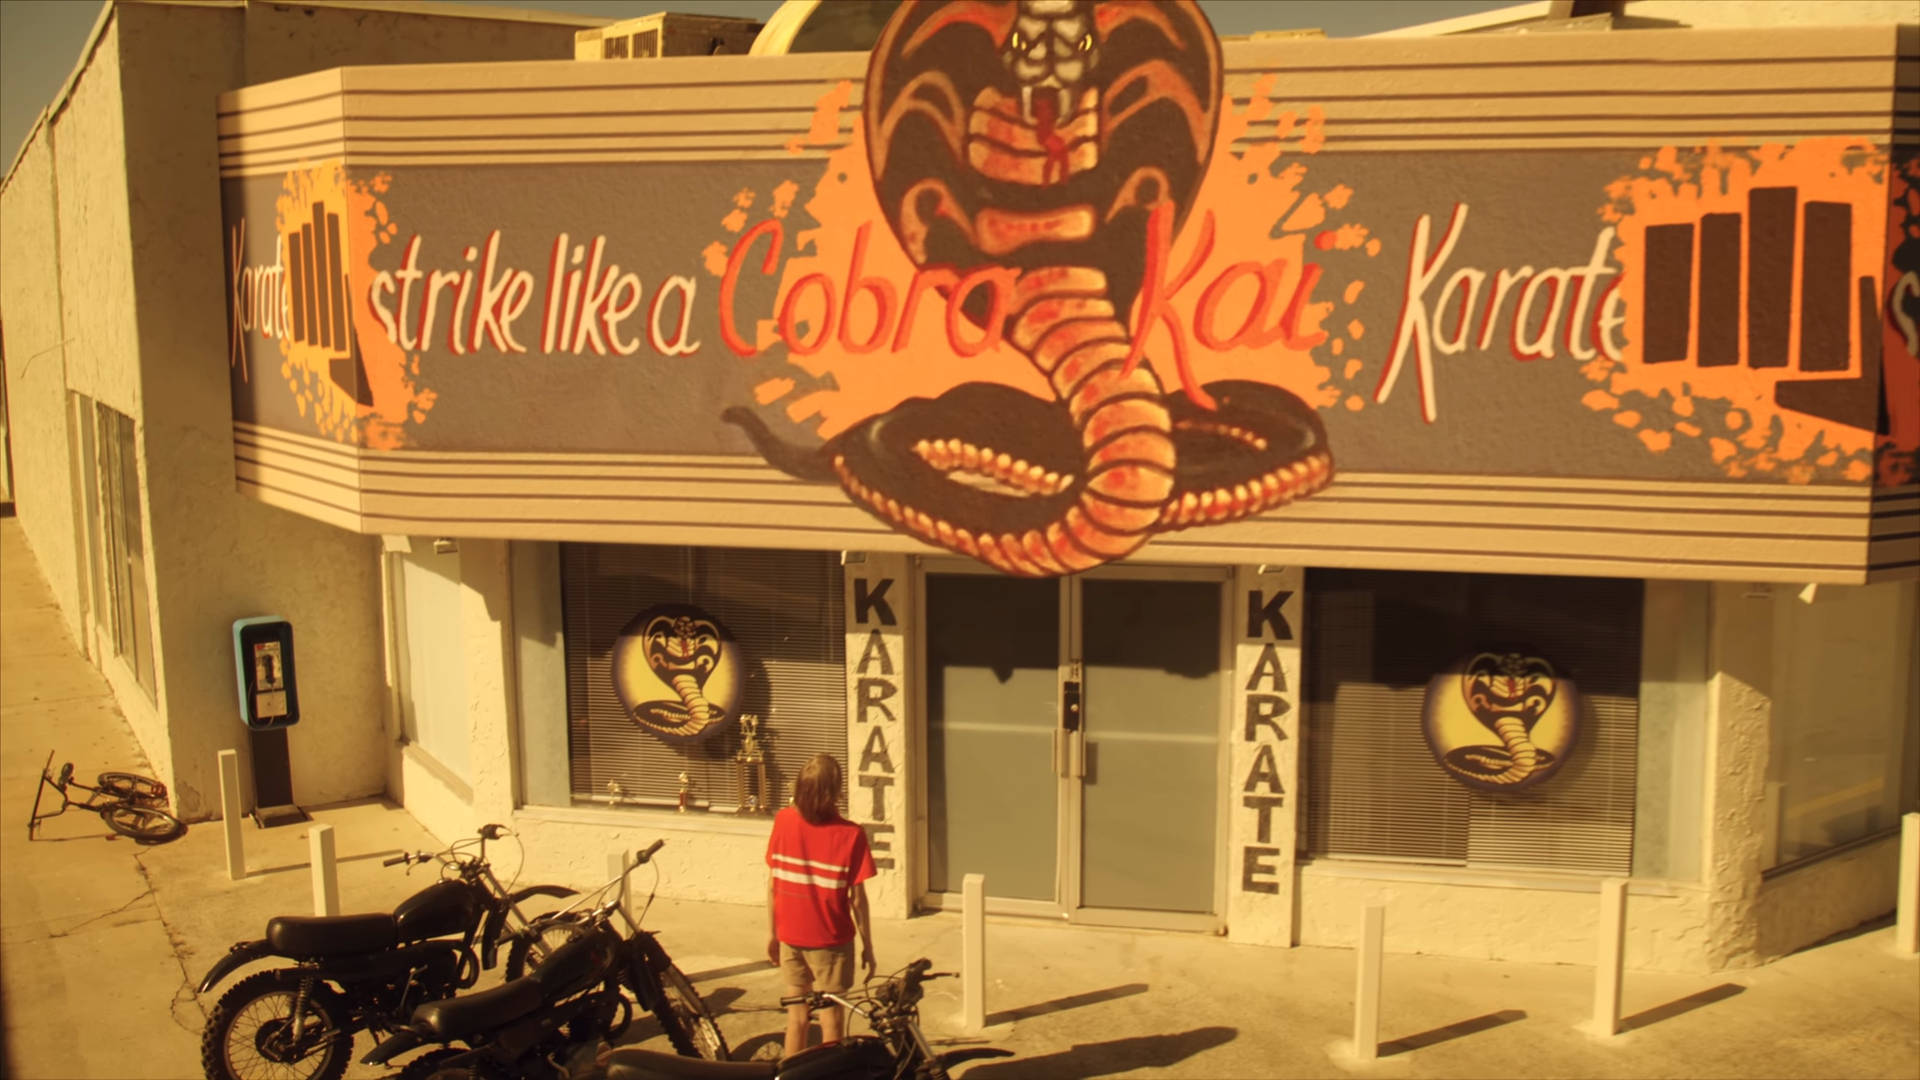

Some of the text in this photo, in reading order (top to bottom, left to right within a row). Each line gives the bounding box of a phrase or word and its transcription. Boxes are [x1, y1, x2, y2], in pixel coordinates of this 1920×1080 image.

[369, 230, 535, 355] strike
[541, 233, 643, 356] like
[646, 275, 701, 358] a
[719, 218, 1021, 358] Cobra
[1119, 199, 1337, 411] Kai
[854, 578, 898, 870] KARATE
[1241, 590, 1294, 895] KARATE
